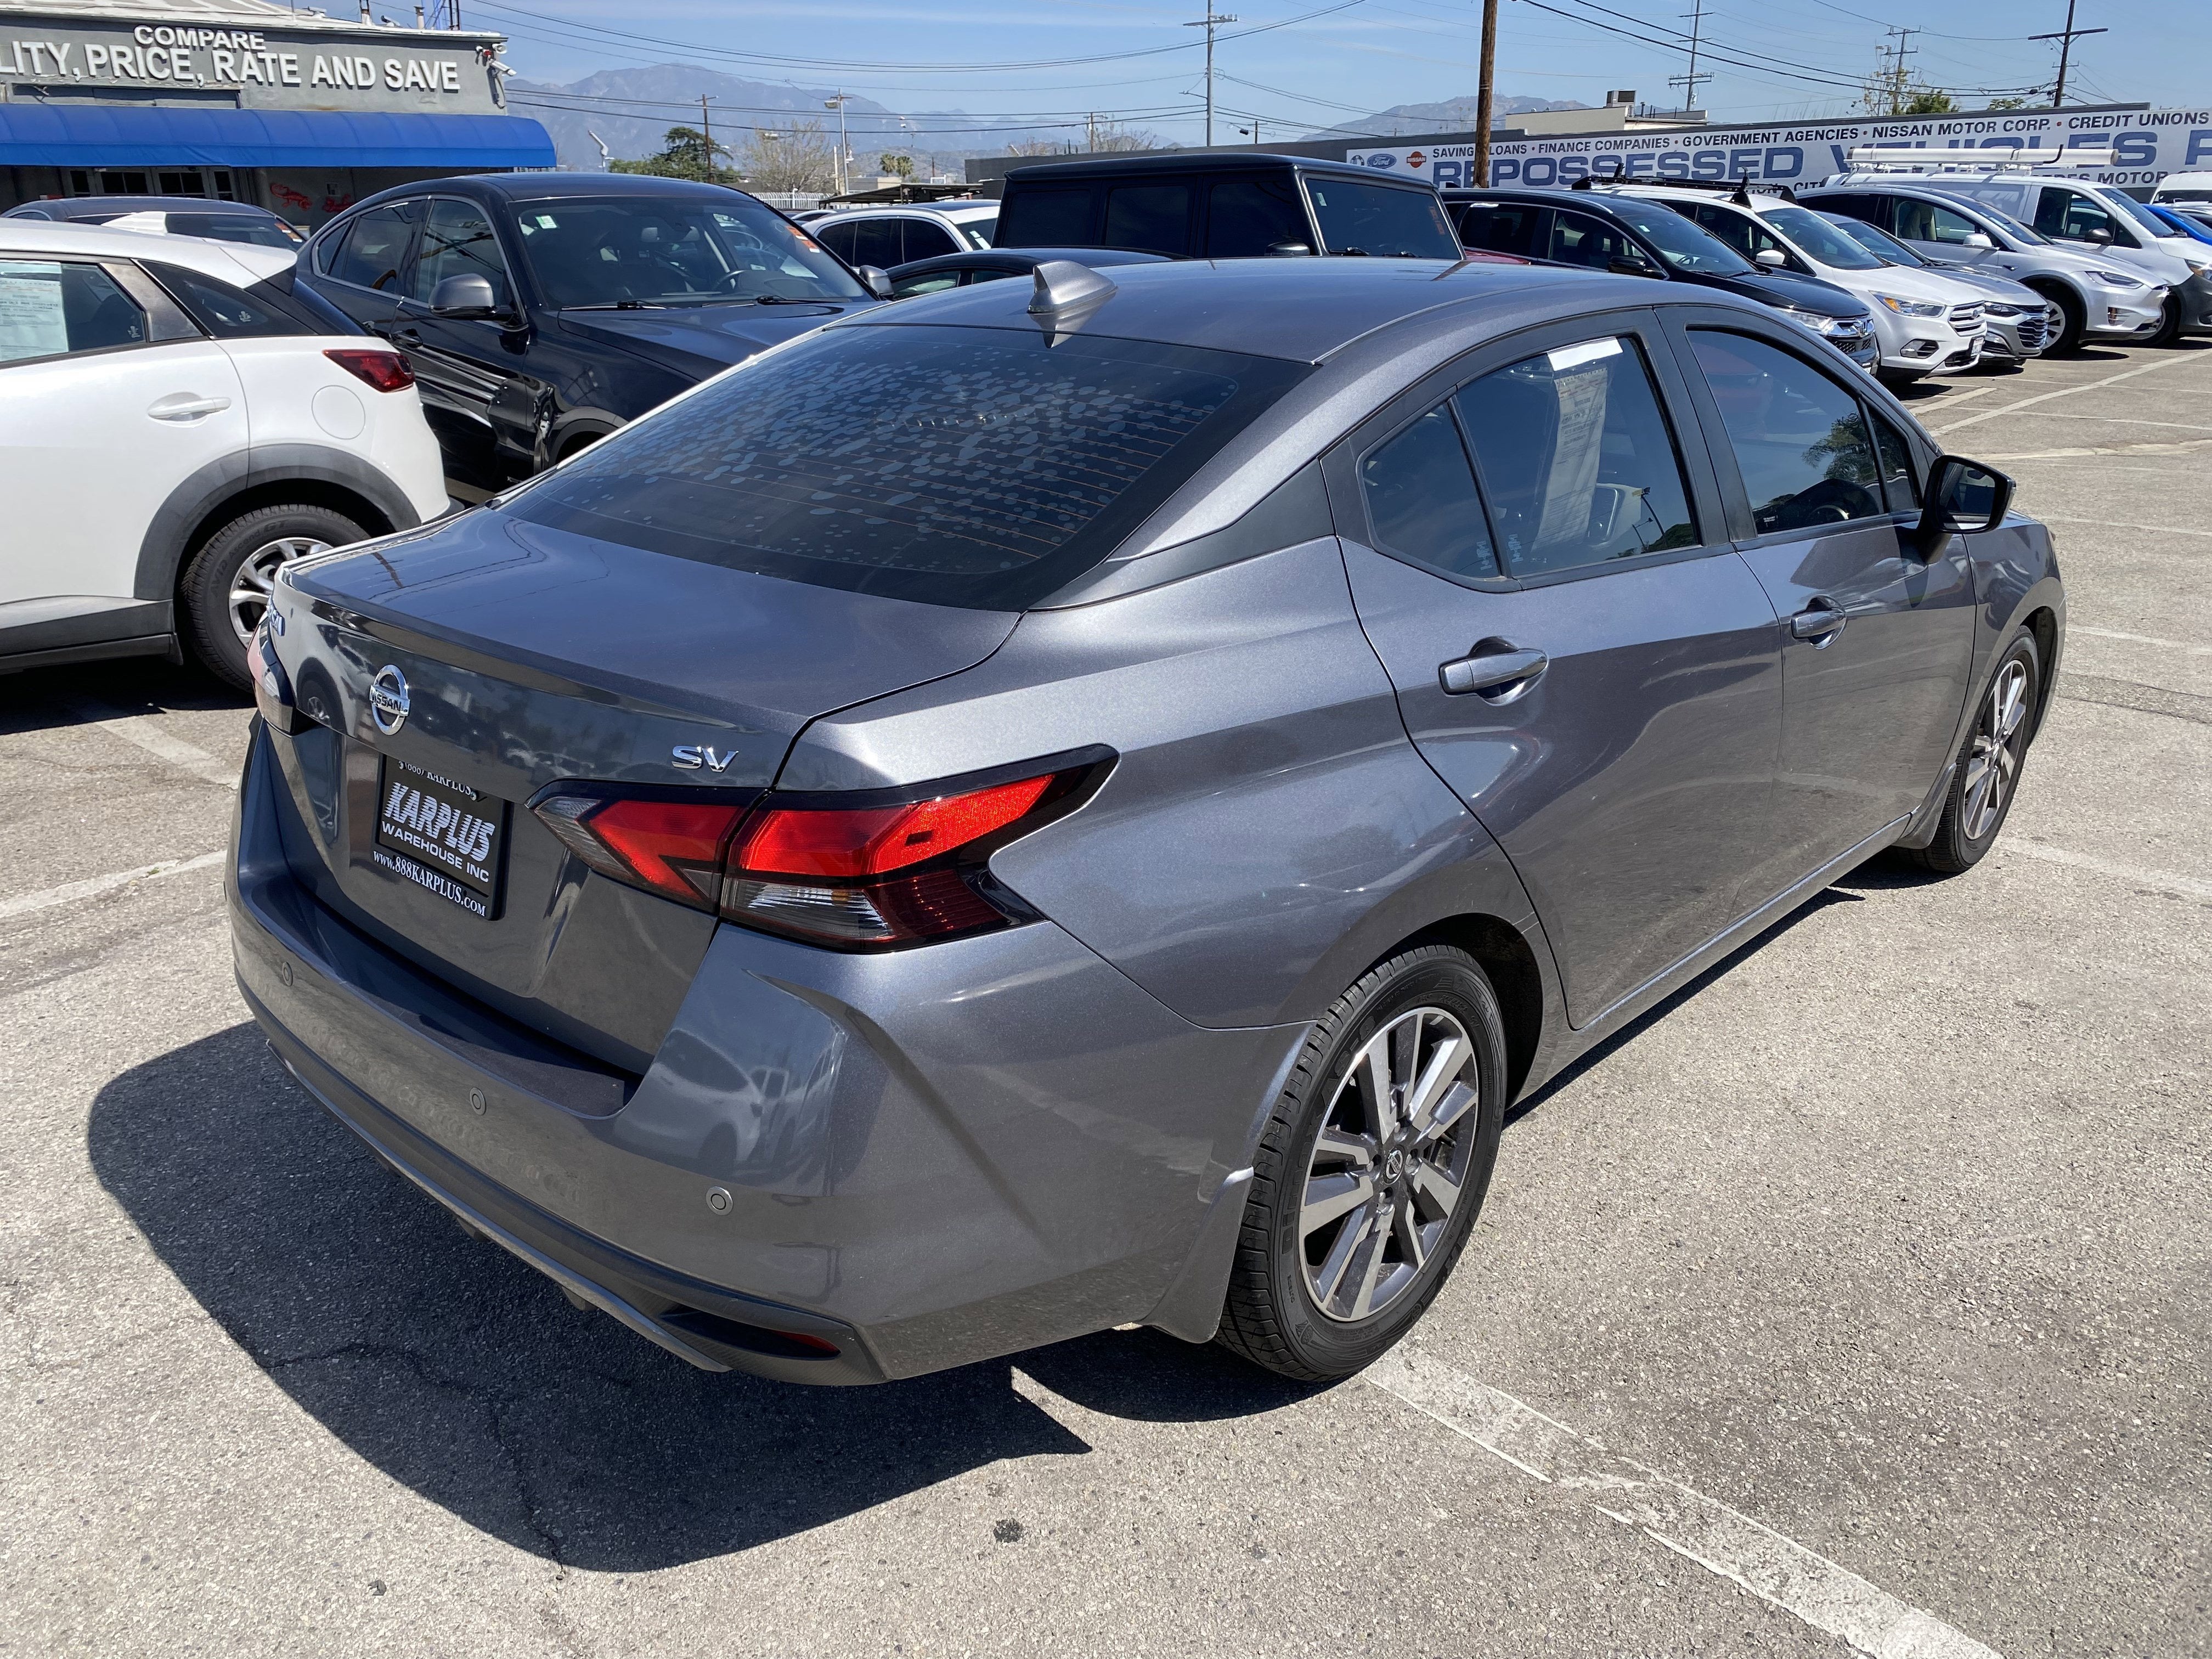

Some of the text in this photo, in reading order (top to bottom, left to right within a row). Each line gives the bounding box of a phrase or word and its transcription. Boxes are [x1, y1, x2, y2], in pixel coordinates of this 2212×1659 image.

[134, 26, 266, 50] COMPARE
[84, 44, 204, 86] PRICE,
[211, 50, 301, 84] RATE
[311, 55, 375, 87] AND
[384, 59, 460, 90] SAVE
[1489, 144, 1527, 155] LOANS
[1538, 142, 1590, 153] FINANCE
[1595, 138, 1670, 151] COMPANIES
[1683, 132, 1780, 146] GOVERNMENT
[1785, 128, 1859, 142] AGENCIES
[1872, 124, 1933, 138] NISSAN
[1938, 121, 1997, 135] MOTOR
[2003, 119, 2050, 132] CORP.
[2068, 114, 2133, 129] CREDIT
[2139, 112, 2209, 126] UNIONS
[370, 689, 402, 712] NISSAN
[672, 745, 739, 772] SV
[383, 782, 495, 862] KARPLUS
[382, 821, 489, 882] WAREHOUSE INC
